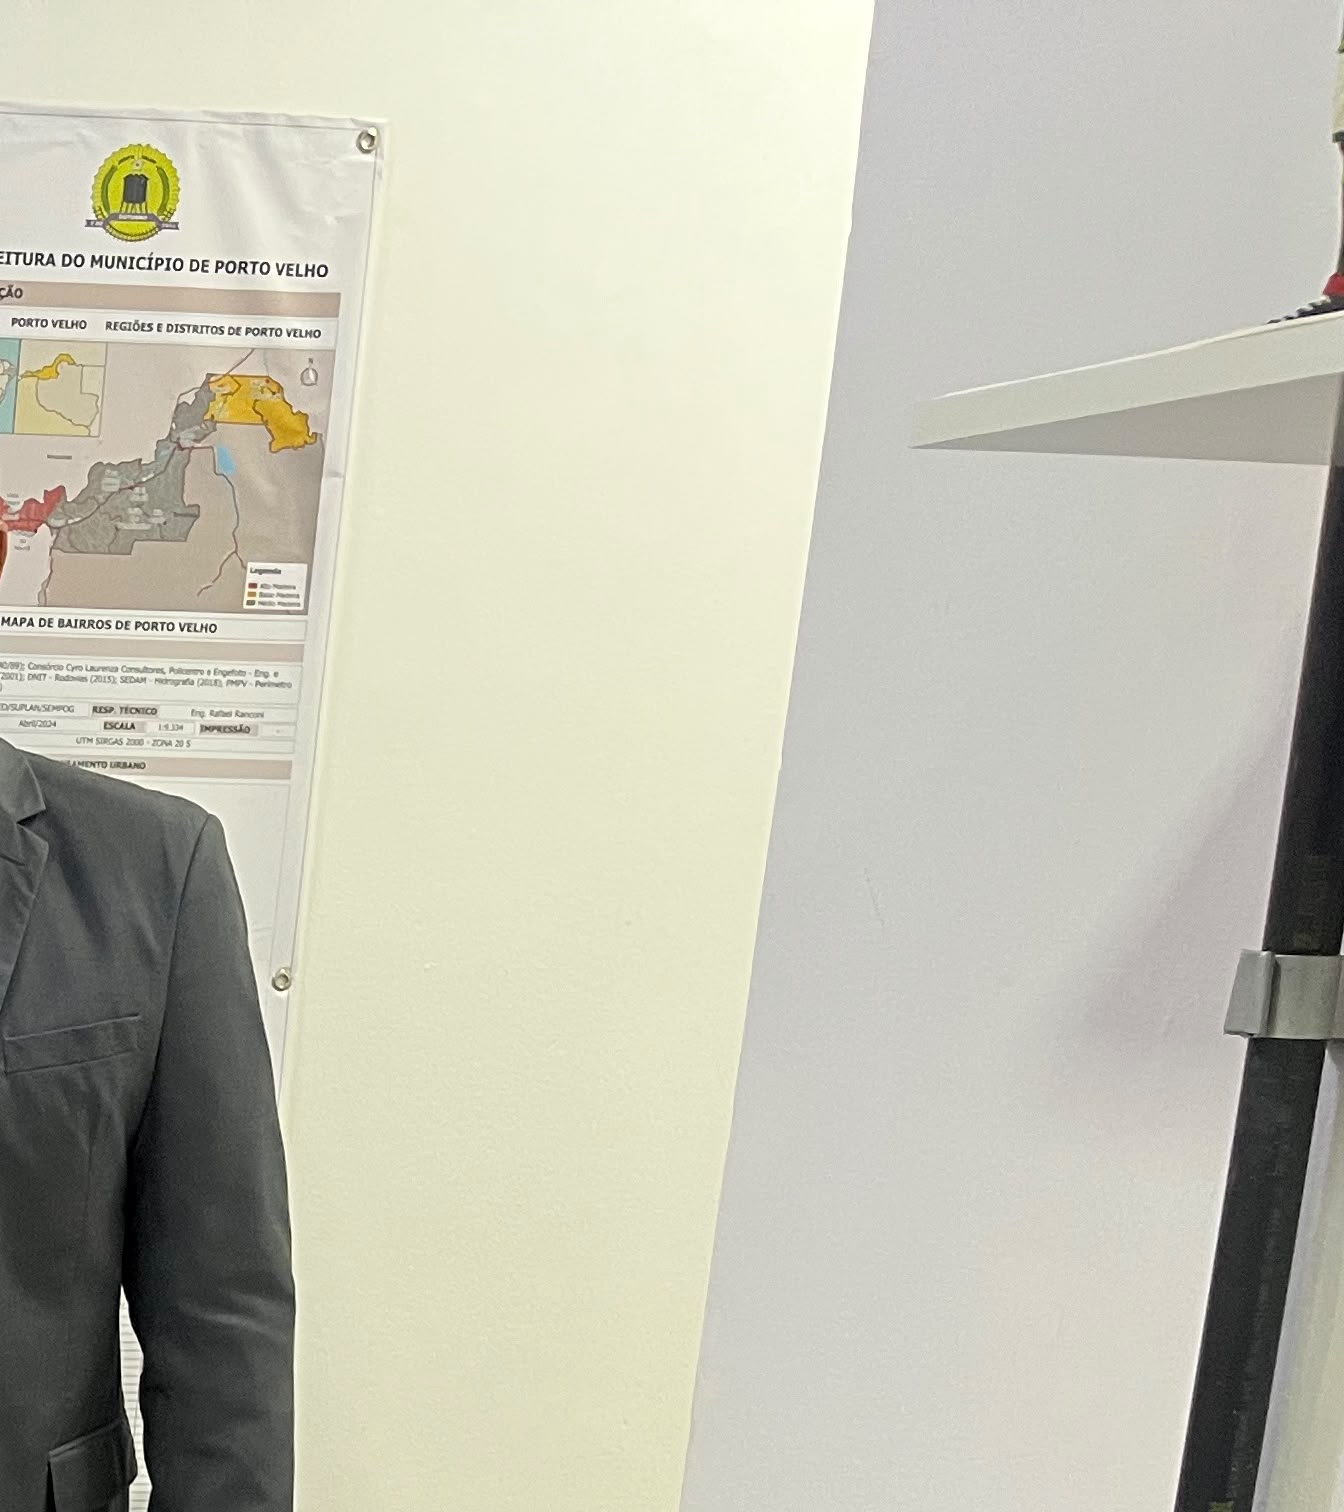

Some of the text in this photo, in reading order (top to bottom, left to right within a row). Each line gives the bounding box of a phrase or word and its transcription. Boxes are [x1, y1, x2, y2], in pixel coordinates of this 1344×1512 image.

[61, 253, 85, 268] DO
[90, 252, 184, 272] MUNICÍPIO
[189, 259, 210, 273] DE
[214, 260, 271, 276] PORTO
[275, 262, 329, 278] VELHO
[11, 317, 87, 330] PORTO VELHO
[105, 320, 322, 339] REGIÕES E DISTRITOS DE PORTO VELHO
[1, 616, 218, 634] MAPA DE BAIRROS DE PORTO VELHO
[103, 721, 136, 731] ESCALA
[199, 724, 251, 734] IMPRESSÃO
[109, 760, 147, 770] URBANO
